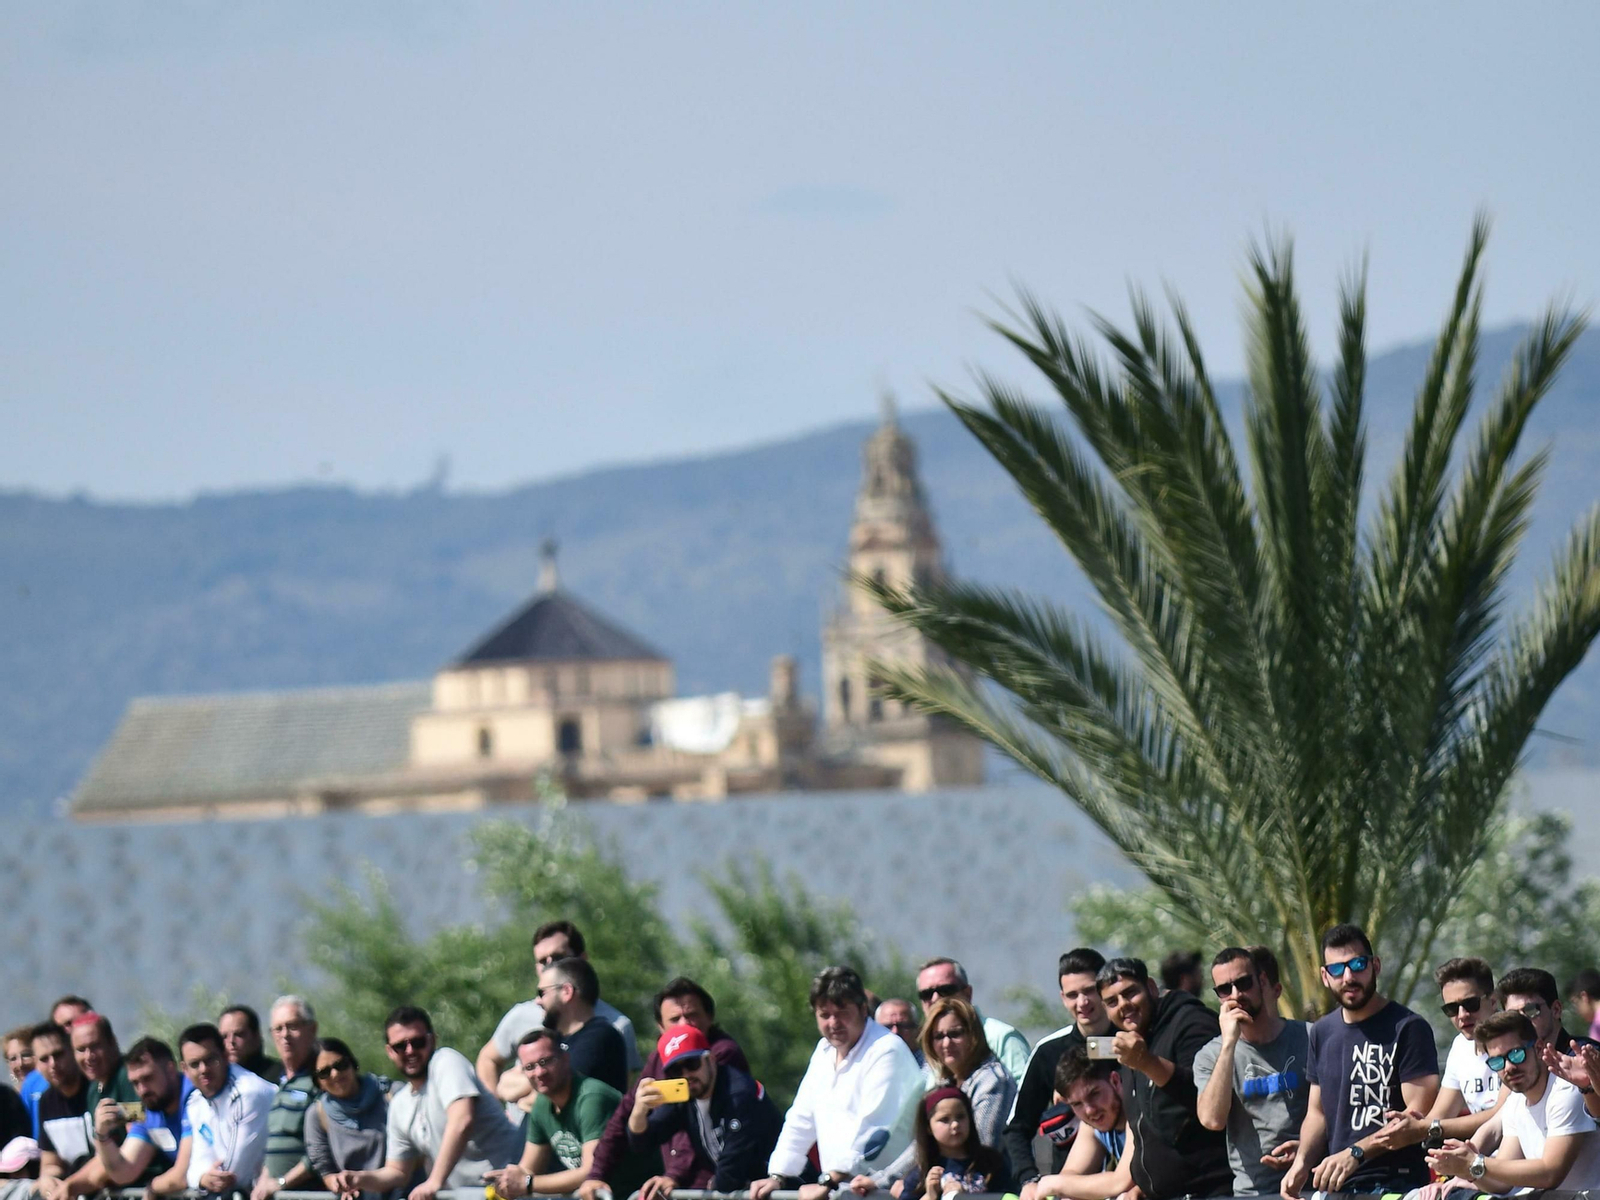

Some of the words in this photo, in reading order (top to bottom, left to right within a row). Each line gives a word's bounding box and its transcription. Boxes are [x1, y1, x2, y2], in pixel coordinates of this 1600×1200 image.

[1352, 1040, 1398, 1065] NEW
[1350, 1061, 1394, 1085] ADV
[1350, 1083, 1396, 1109] ENT
